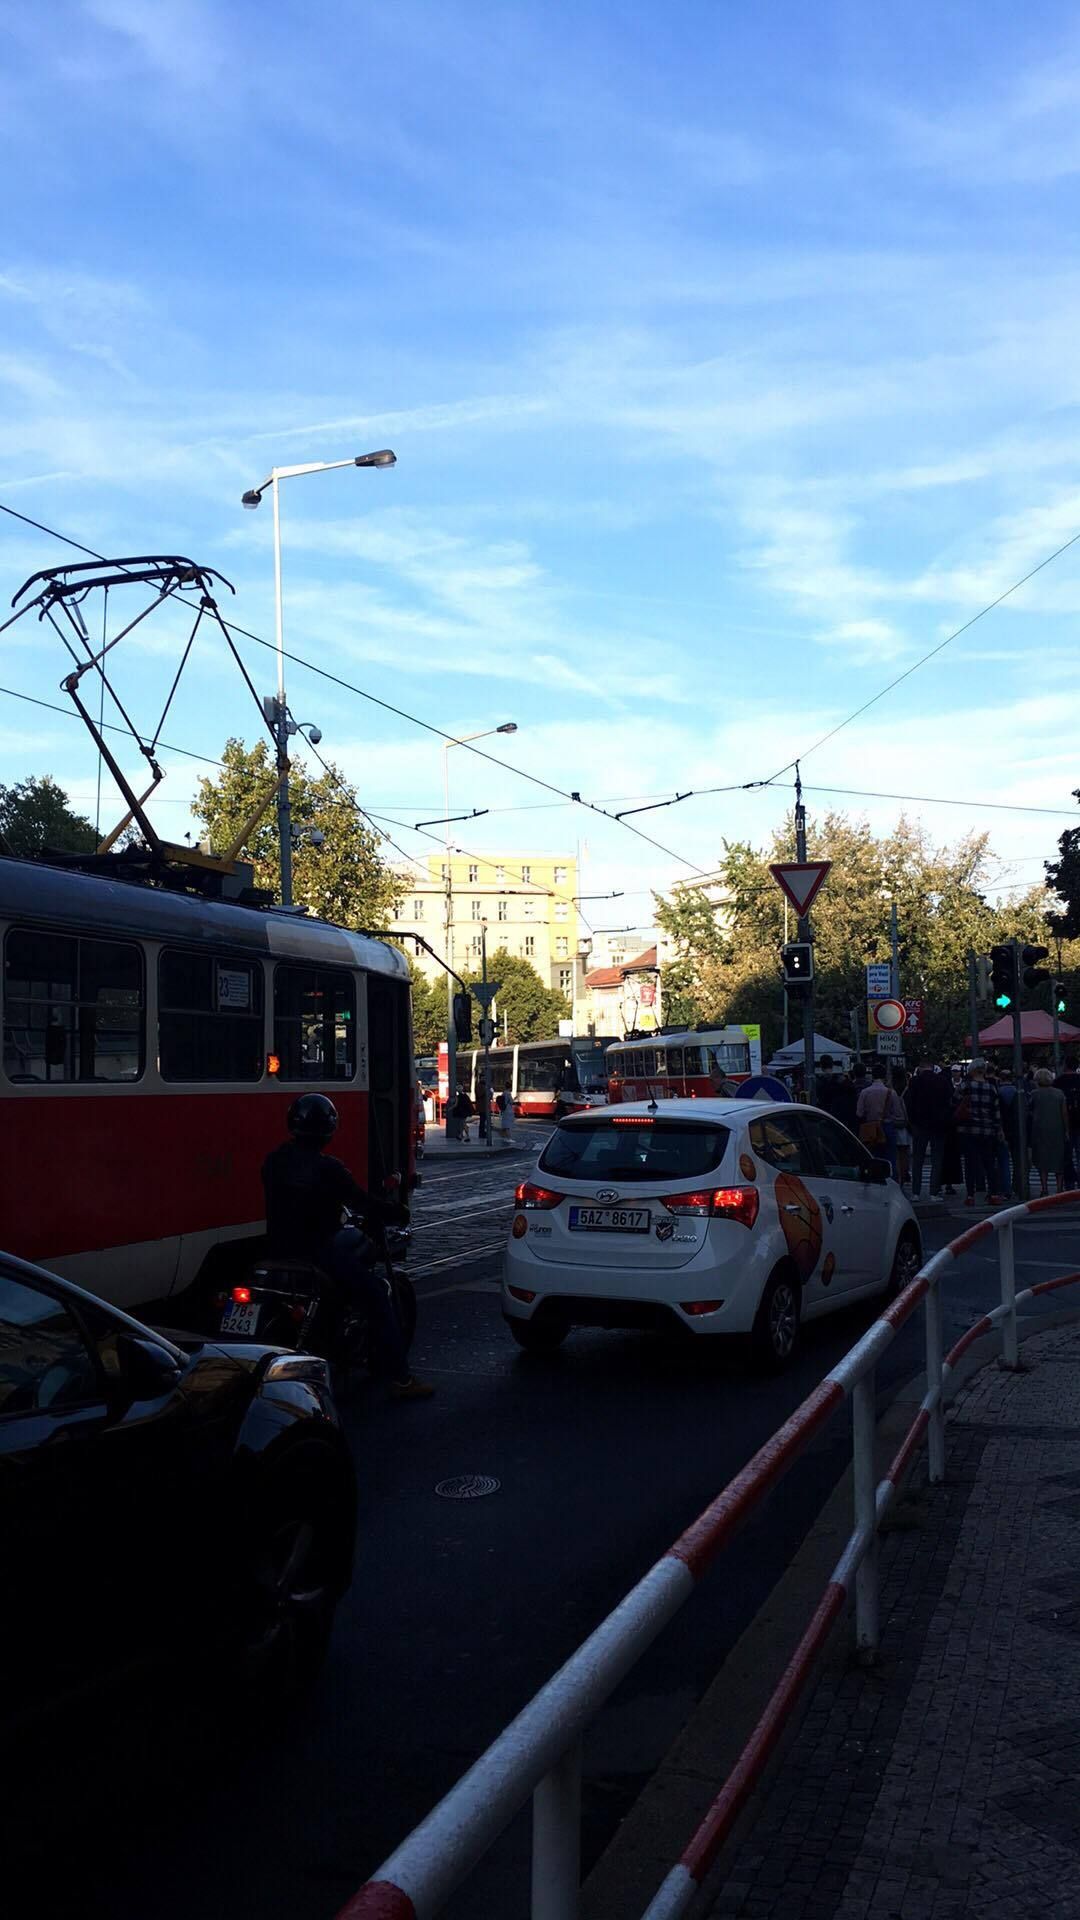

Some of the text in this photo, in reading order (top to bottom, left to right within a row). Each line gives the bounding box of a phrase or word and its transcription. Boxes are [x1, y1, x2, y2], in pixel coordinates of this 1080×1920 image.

[219, 976, 229, 997] 23
[580, 1210, 603, 1225] 5AZ
[612, 1211, 643, 1226] 8617
[223, 1318, 251, 1332] 5243
